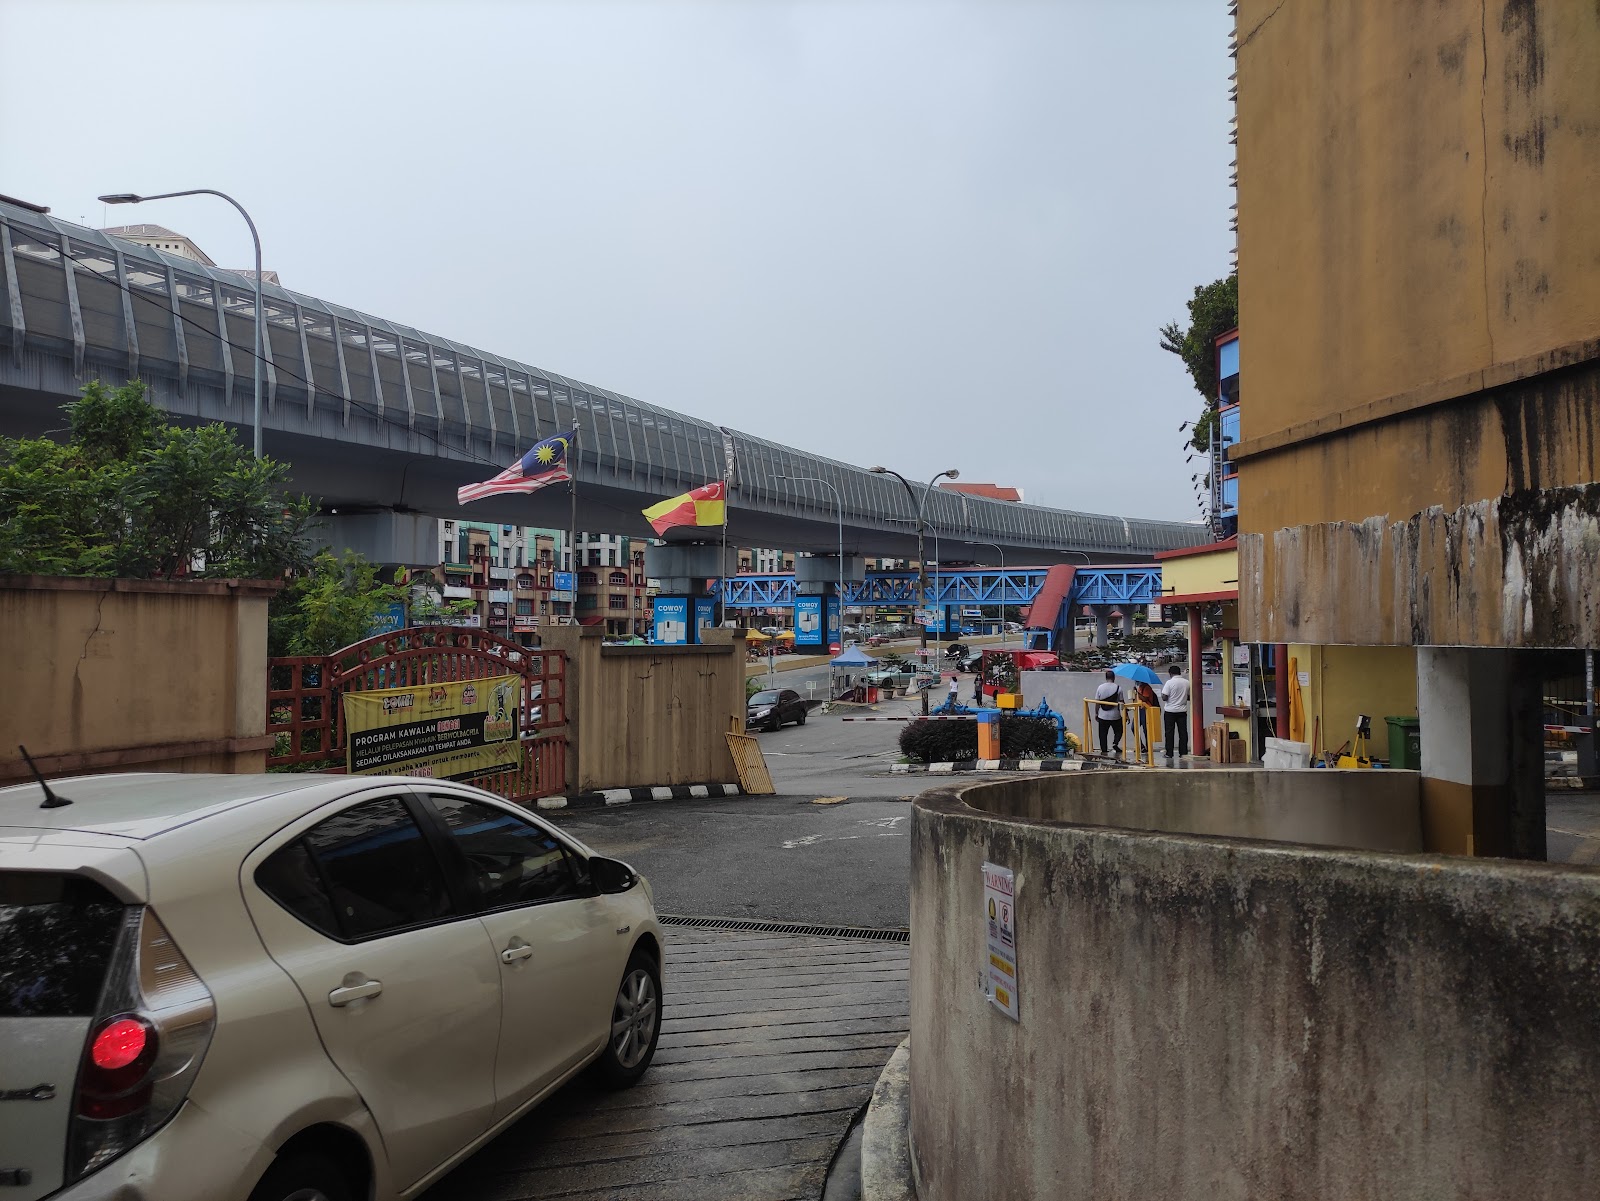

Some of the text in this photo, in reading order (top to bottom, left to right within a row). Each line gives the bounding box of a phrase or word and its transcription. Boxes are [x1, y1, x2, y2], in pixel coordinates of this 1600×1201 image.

[355, 733, 396, 747] PROGRAM
[399, 725, 436, 738] KAWALAN
[356, 746, 381, 757] MELALUI
[381, 740, 413, 752] PELEPASAN
[356, 756, 382, 767] SEDANG
[382, 745, 427, 761] DILAKSANAKAN
[435, 740, 457, 750] TEMPAT
[456, 738, 472, 746] ANDA
[986, 872, 1013, 893] WARNING
